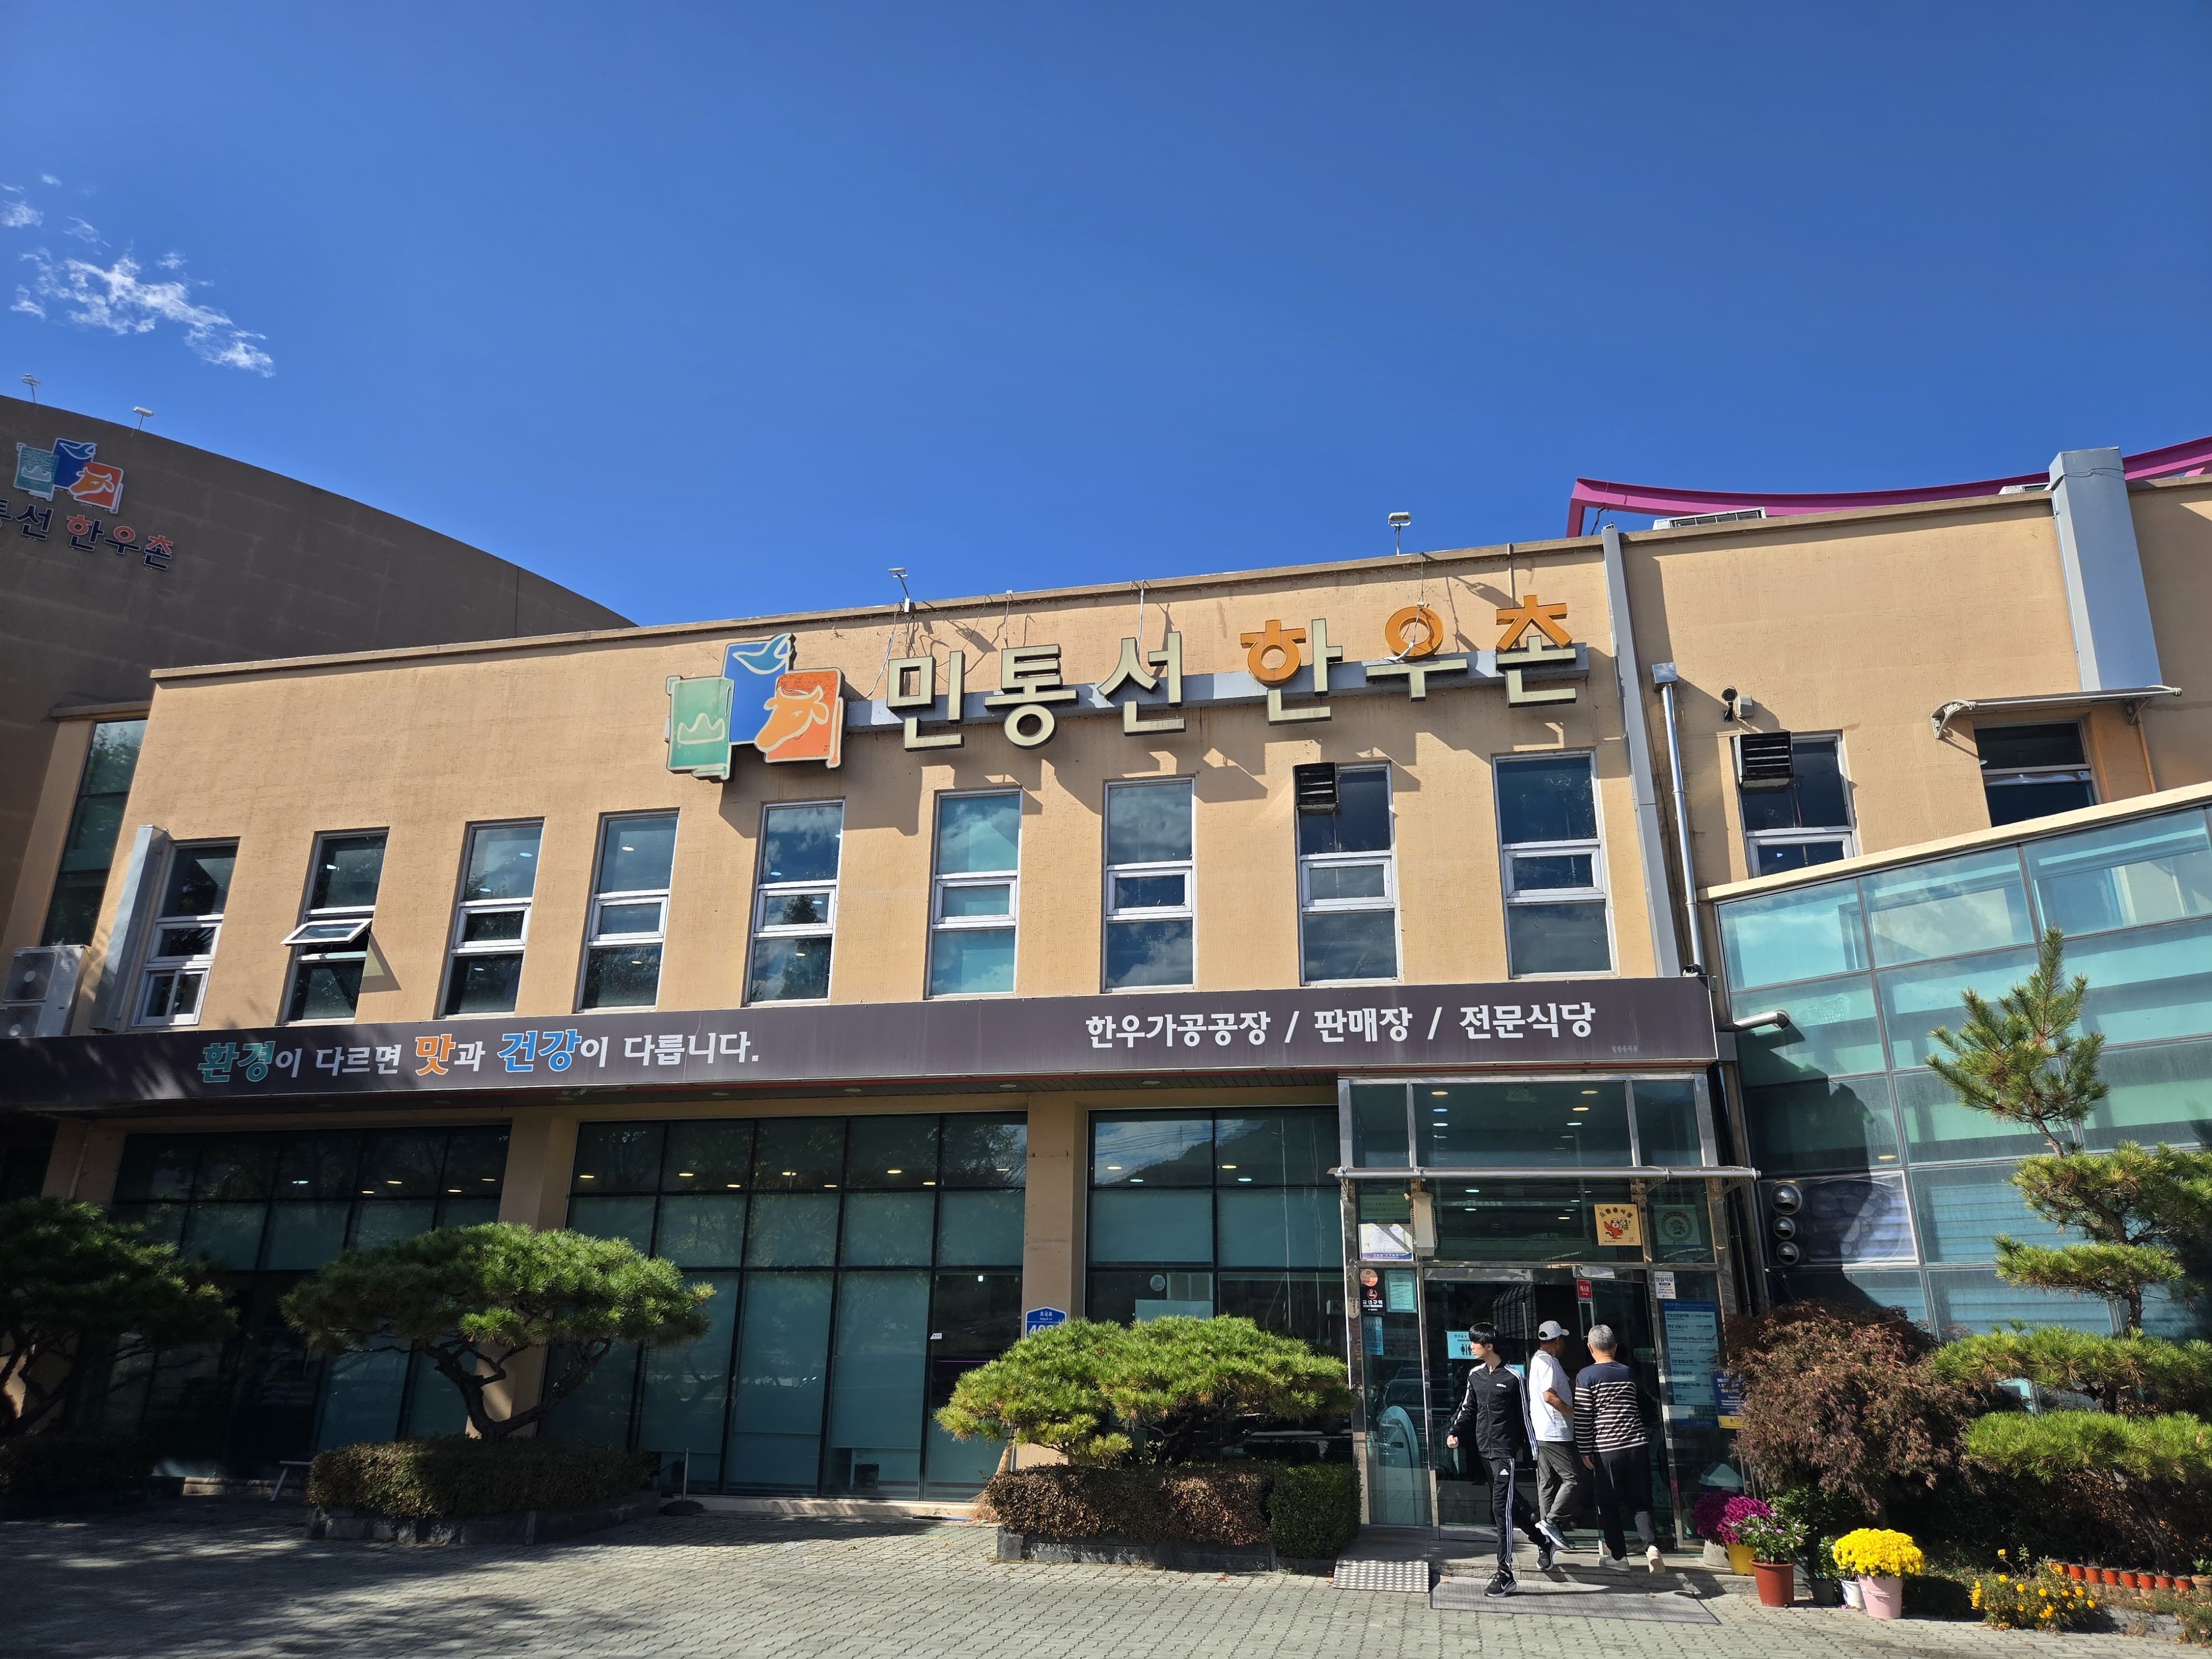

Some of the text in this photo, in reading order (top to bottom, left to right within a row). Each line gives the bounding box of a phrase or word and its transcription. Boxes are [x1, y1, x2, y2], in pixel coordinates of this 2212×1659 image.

[66, 514, 173, 570] 한우촌
[886, 594, 1578, 752] 민통선 한우촌
[1086, 1011, 1271, 1048] 한우가공공장
[1314, 1007, 1413, 1042] 판매장
[1459, 1002, 1596, 1040] 전문식당
[197, 1029, 760, 1083] 환경이 다르면 맛과 건강이 다릅니다.
